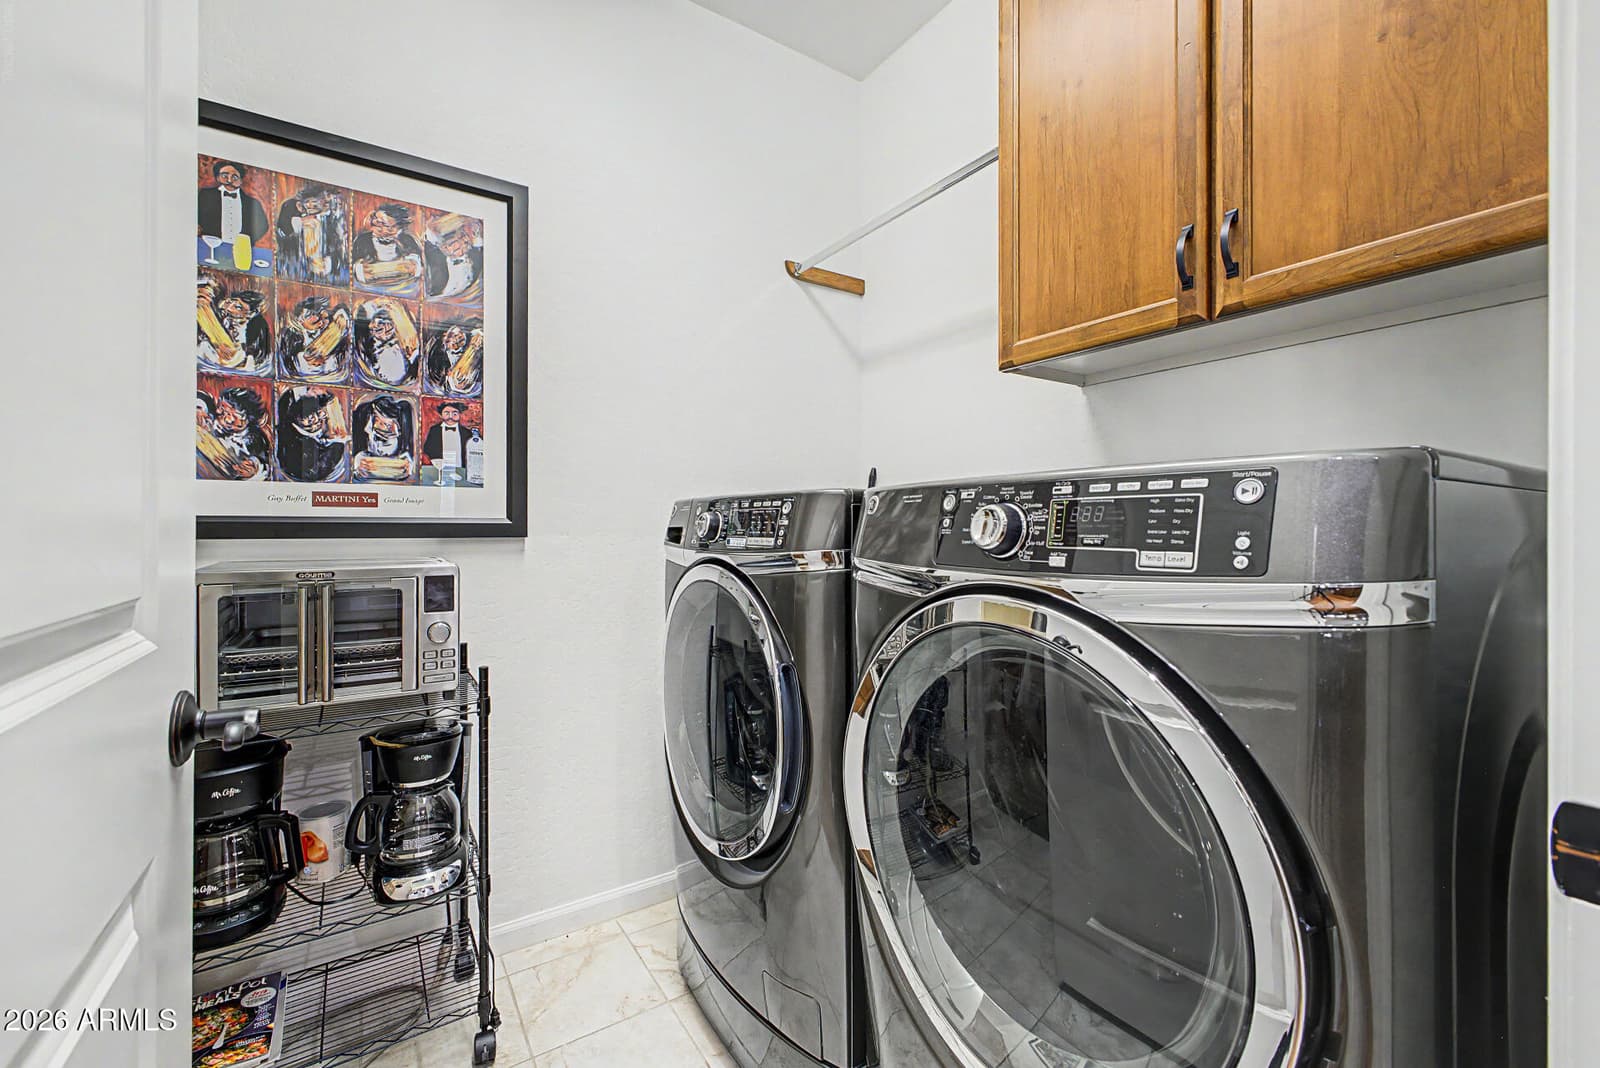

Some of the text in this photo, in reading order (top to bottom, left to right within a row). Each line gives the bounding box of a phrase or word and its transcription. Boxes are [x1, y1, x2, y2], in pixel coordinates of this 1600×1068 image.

[315, 495, 360, 503] MARTINI
[1145, 554, 1162, 562] Temp
[222, 787, 241, 798] Coffee
[200, 885, 219, 895] Coffee
